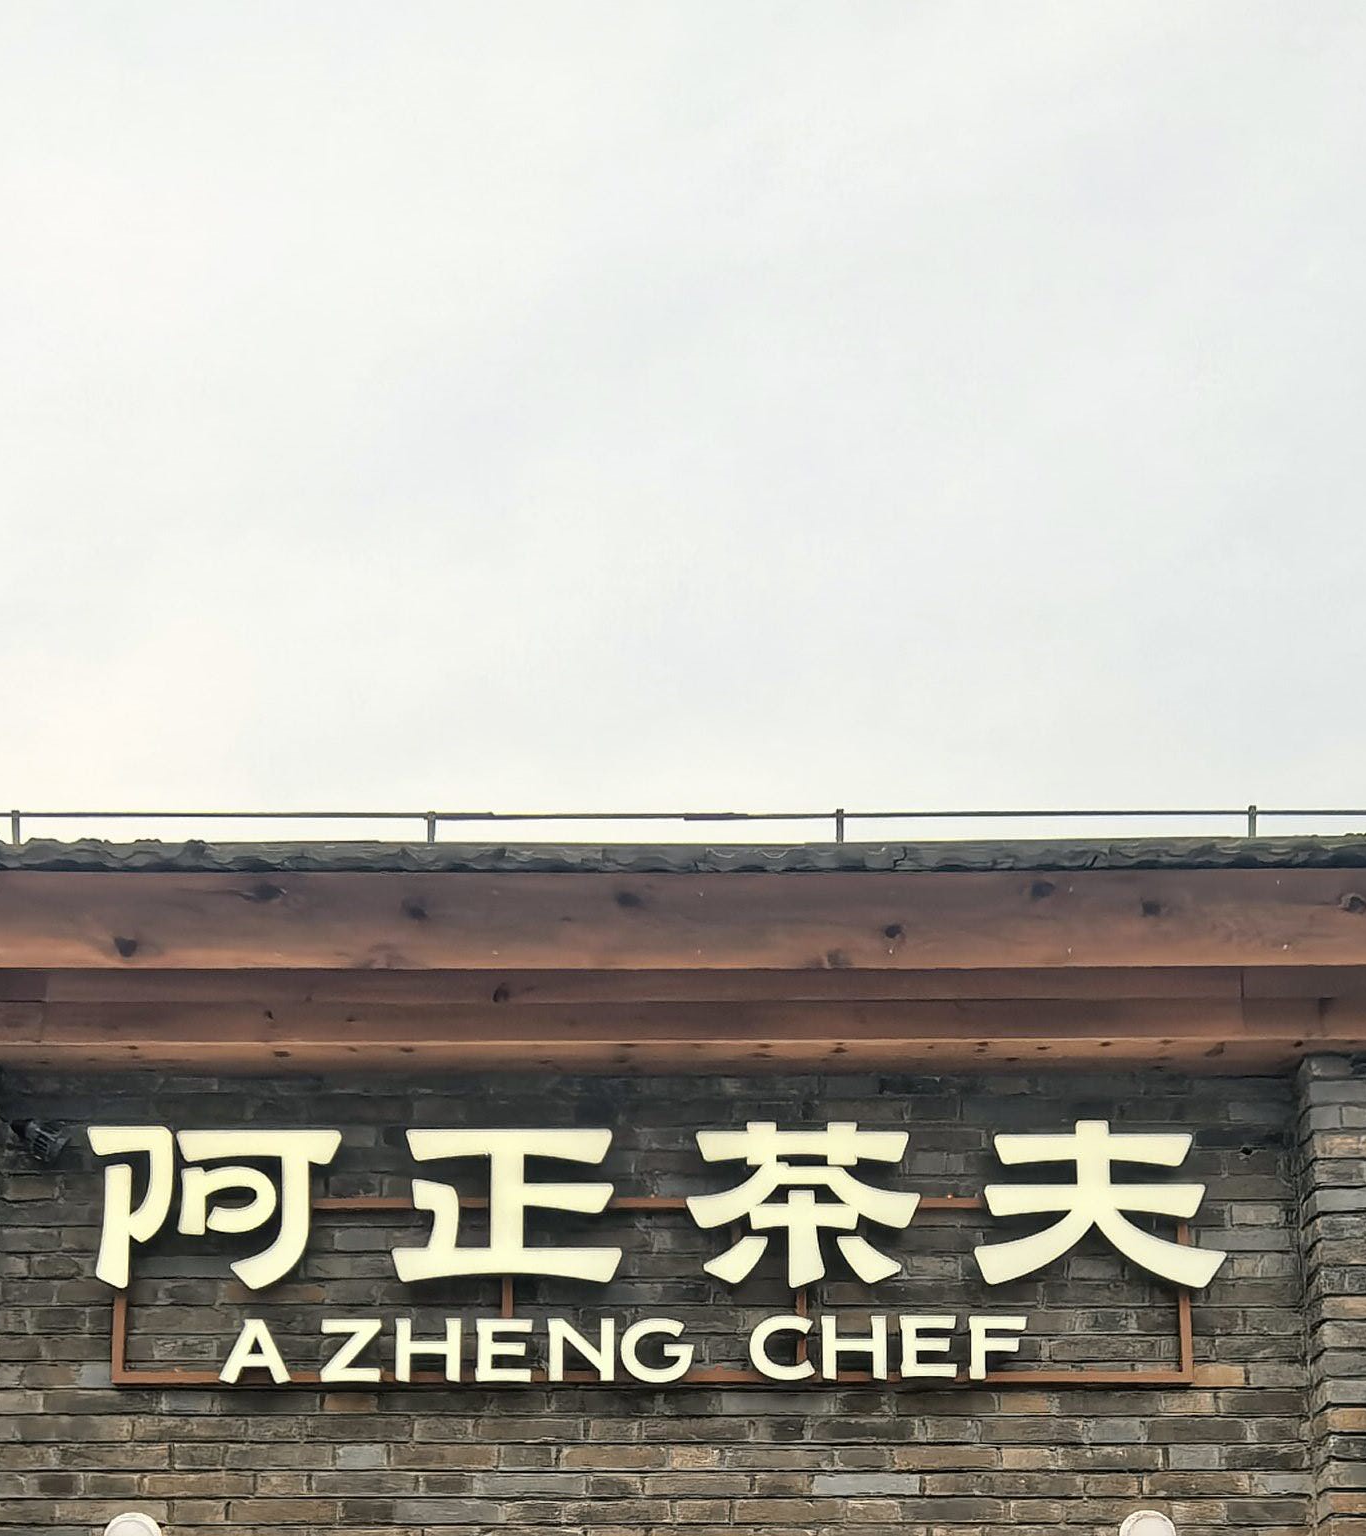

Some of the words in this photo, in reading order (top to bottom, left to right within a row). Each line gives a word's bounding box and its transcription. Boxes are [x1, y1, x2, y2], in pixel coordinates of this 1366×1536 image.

[87, 1119, 1226, 1290] 阿正茶夫
[219, 1317, 291, 1384] A
[318, 1317, 698, 1384] ZHENG
[748, 1314, 1028, 1382] CHEF
